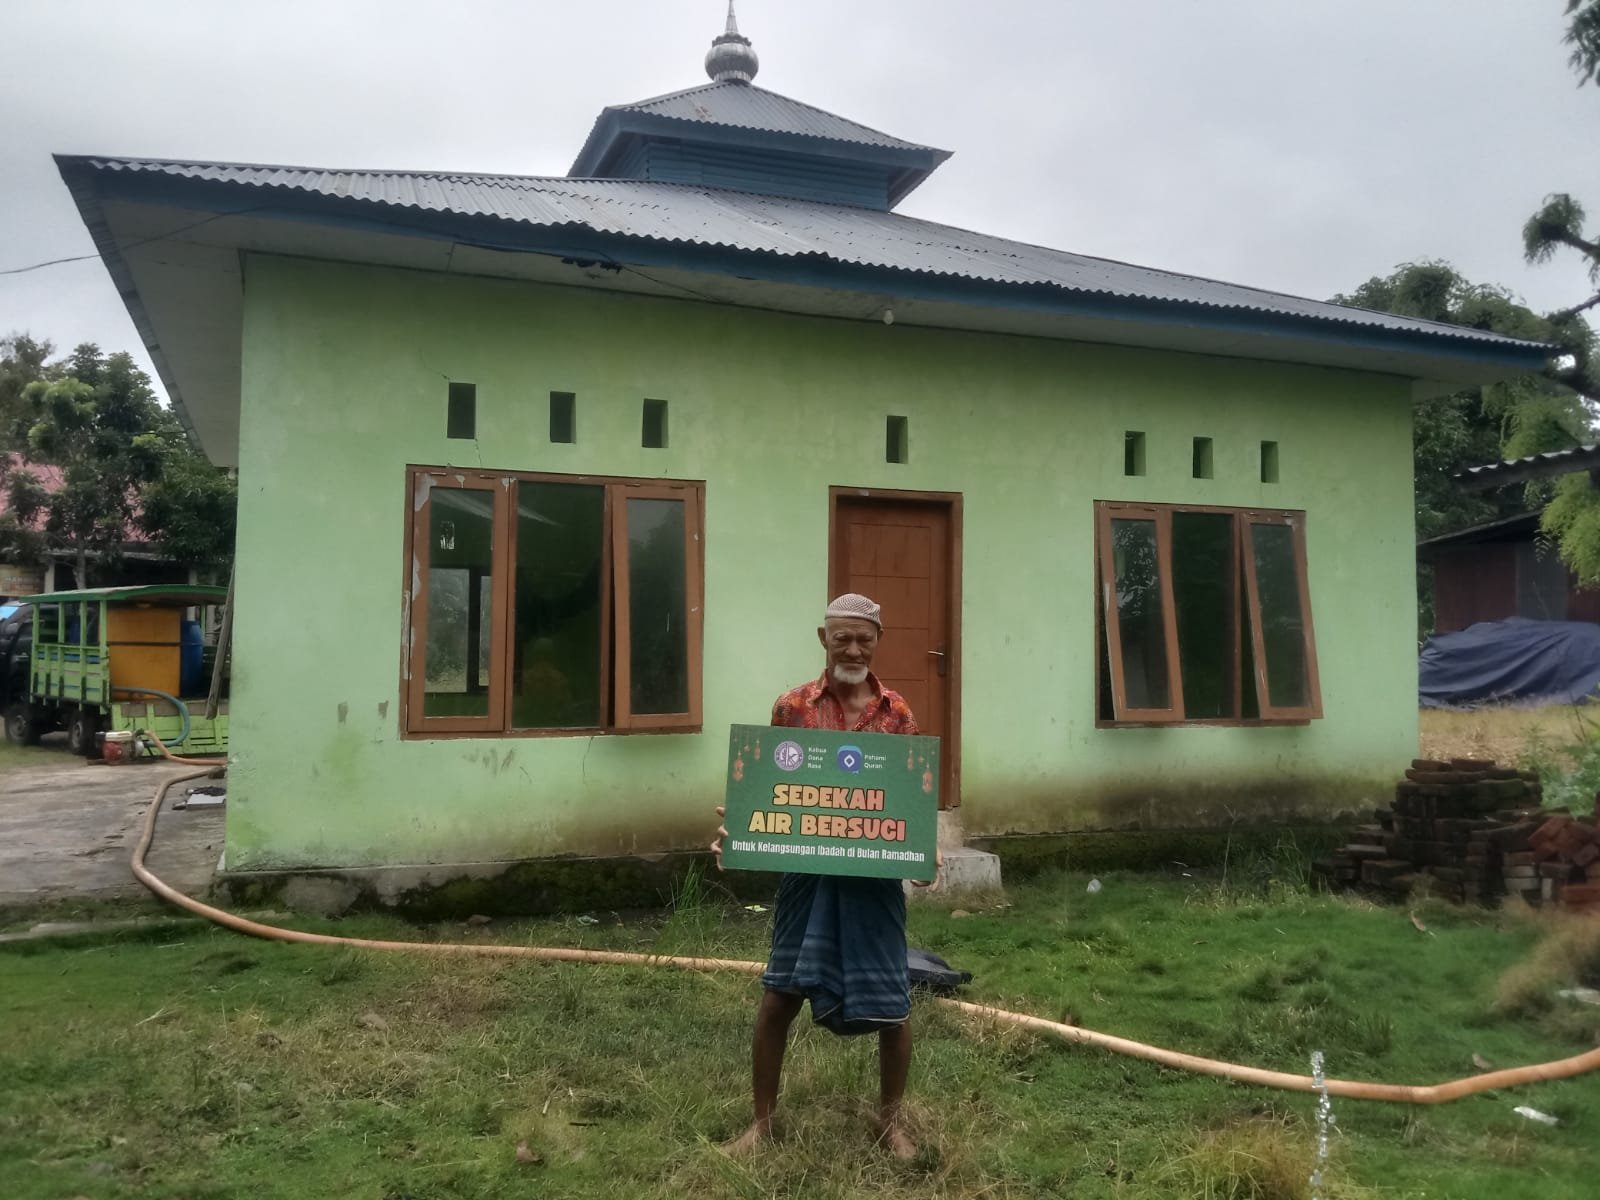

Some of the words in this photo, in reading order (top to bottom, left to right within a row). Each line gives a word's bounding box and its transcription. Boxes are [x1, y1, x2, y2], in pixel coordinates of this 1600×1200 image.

[772, 783, 885, 811] SEDEKAH
[748, 810, 793, 835] AIR
[800, 813, 907, 842] BERSUCI
[732, 840, 756, 852] Untuk
[757, 841, 816, 856] Kelangsungan
[817, 846, 845, 857] Ibadah
[847, 847, 855, 858] di
[857, 848, 880, 860] Bulan
[881, 849, 925, 862] Ramadhan
